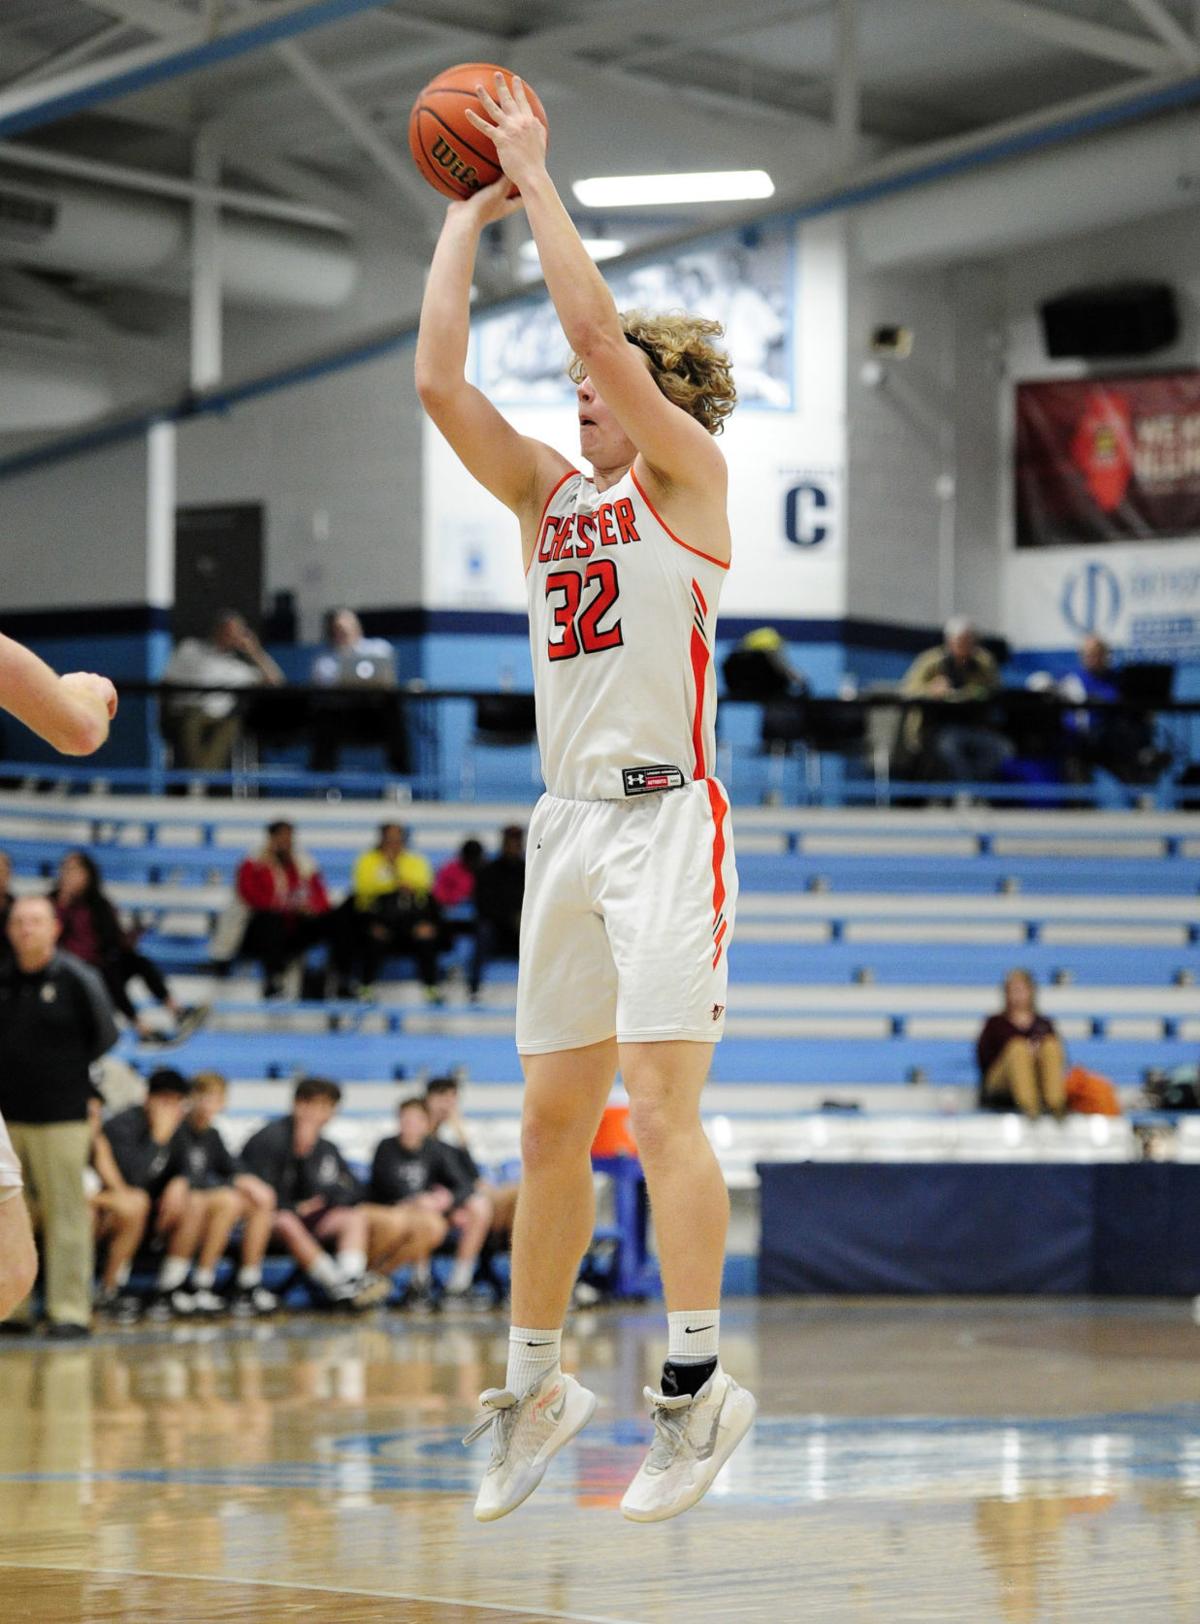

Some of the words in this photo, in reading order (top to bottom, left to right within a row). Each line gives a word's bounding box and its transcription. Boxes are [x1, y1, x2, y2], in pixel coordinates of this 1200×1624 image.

[538, 497, 642, 563] CHESER
[785, 483, 827, 547] C
[545, 558, 624, 662] 32
